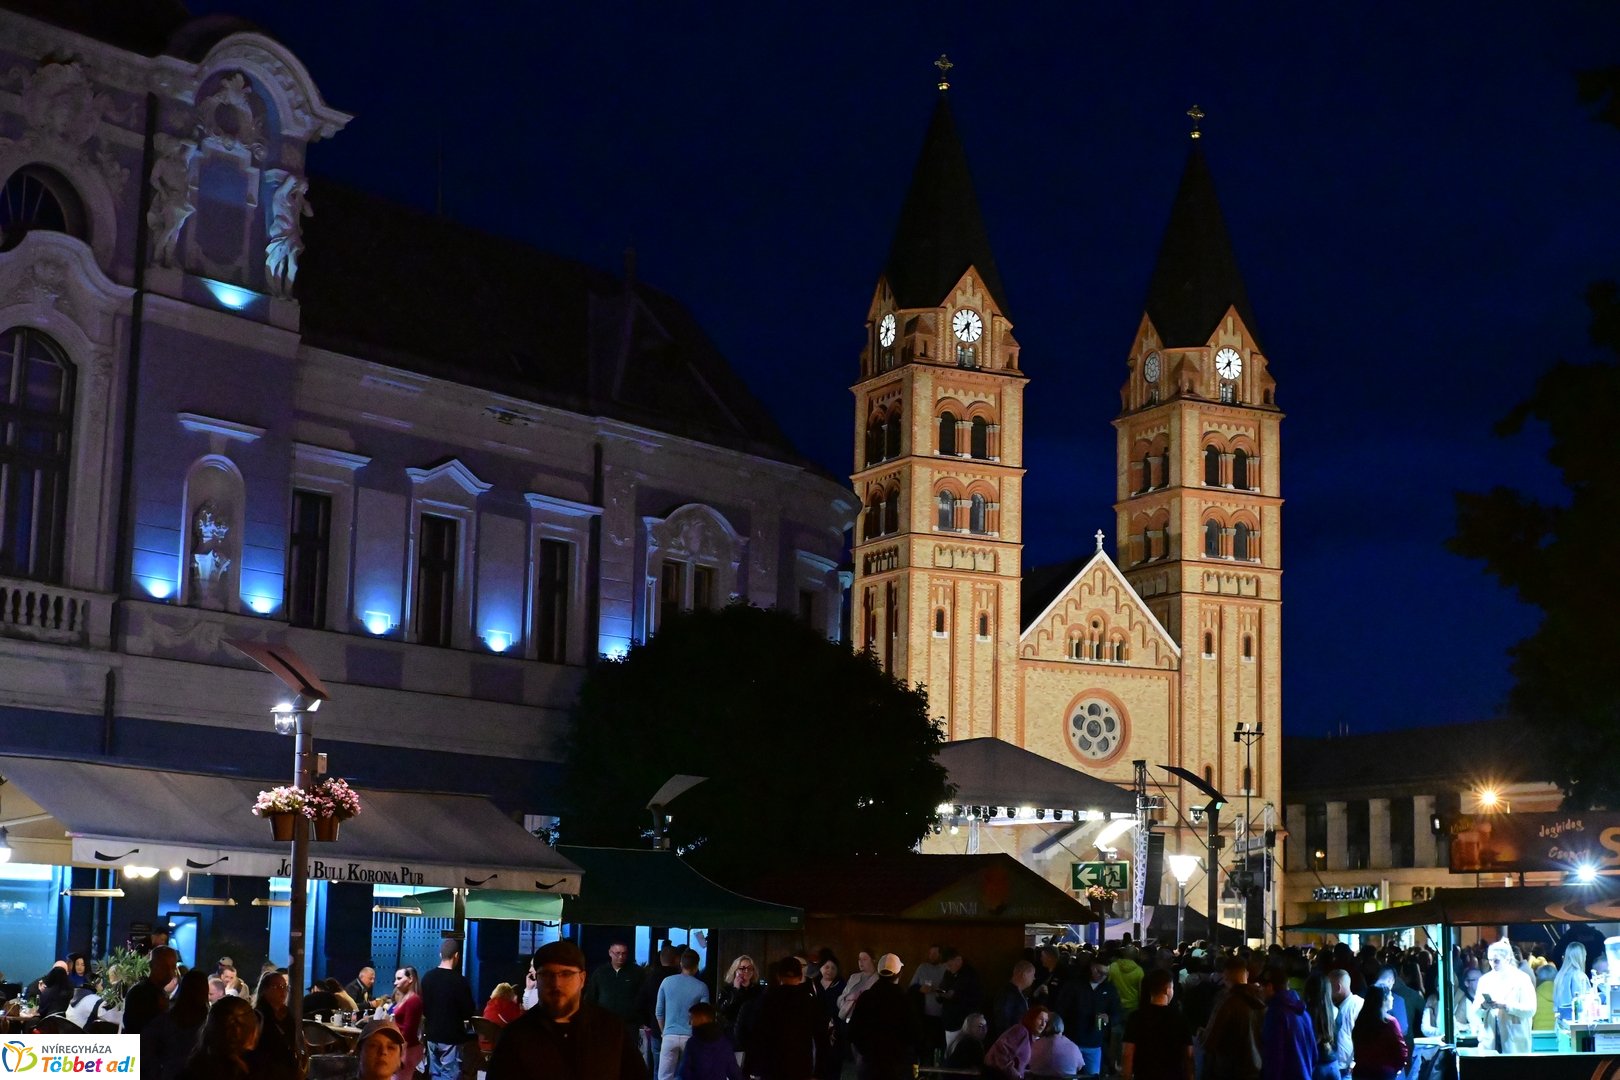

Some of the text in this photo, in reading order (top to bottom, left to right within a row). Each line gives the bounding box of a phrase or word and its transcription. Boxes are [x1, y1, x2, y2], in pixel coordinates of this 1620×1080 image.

[277, 858, 424, 885] JON BULL KORONA PUB
[1353, 886, 1376, 899] BANK
